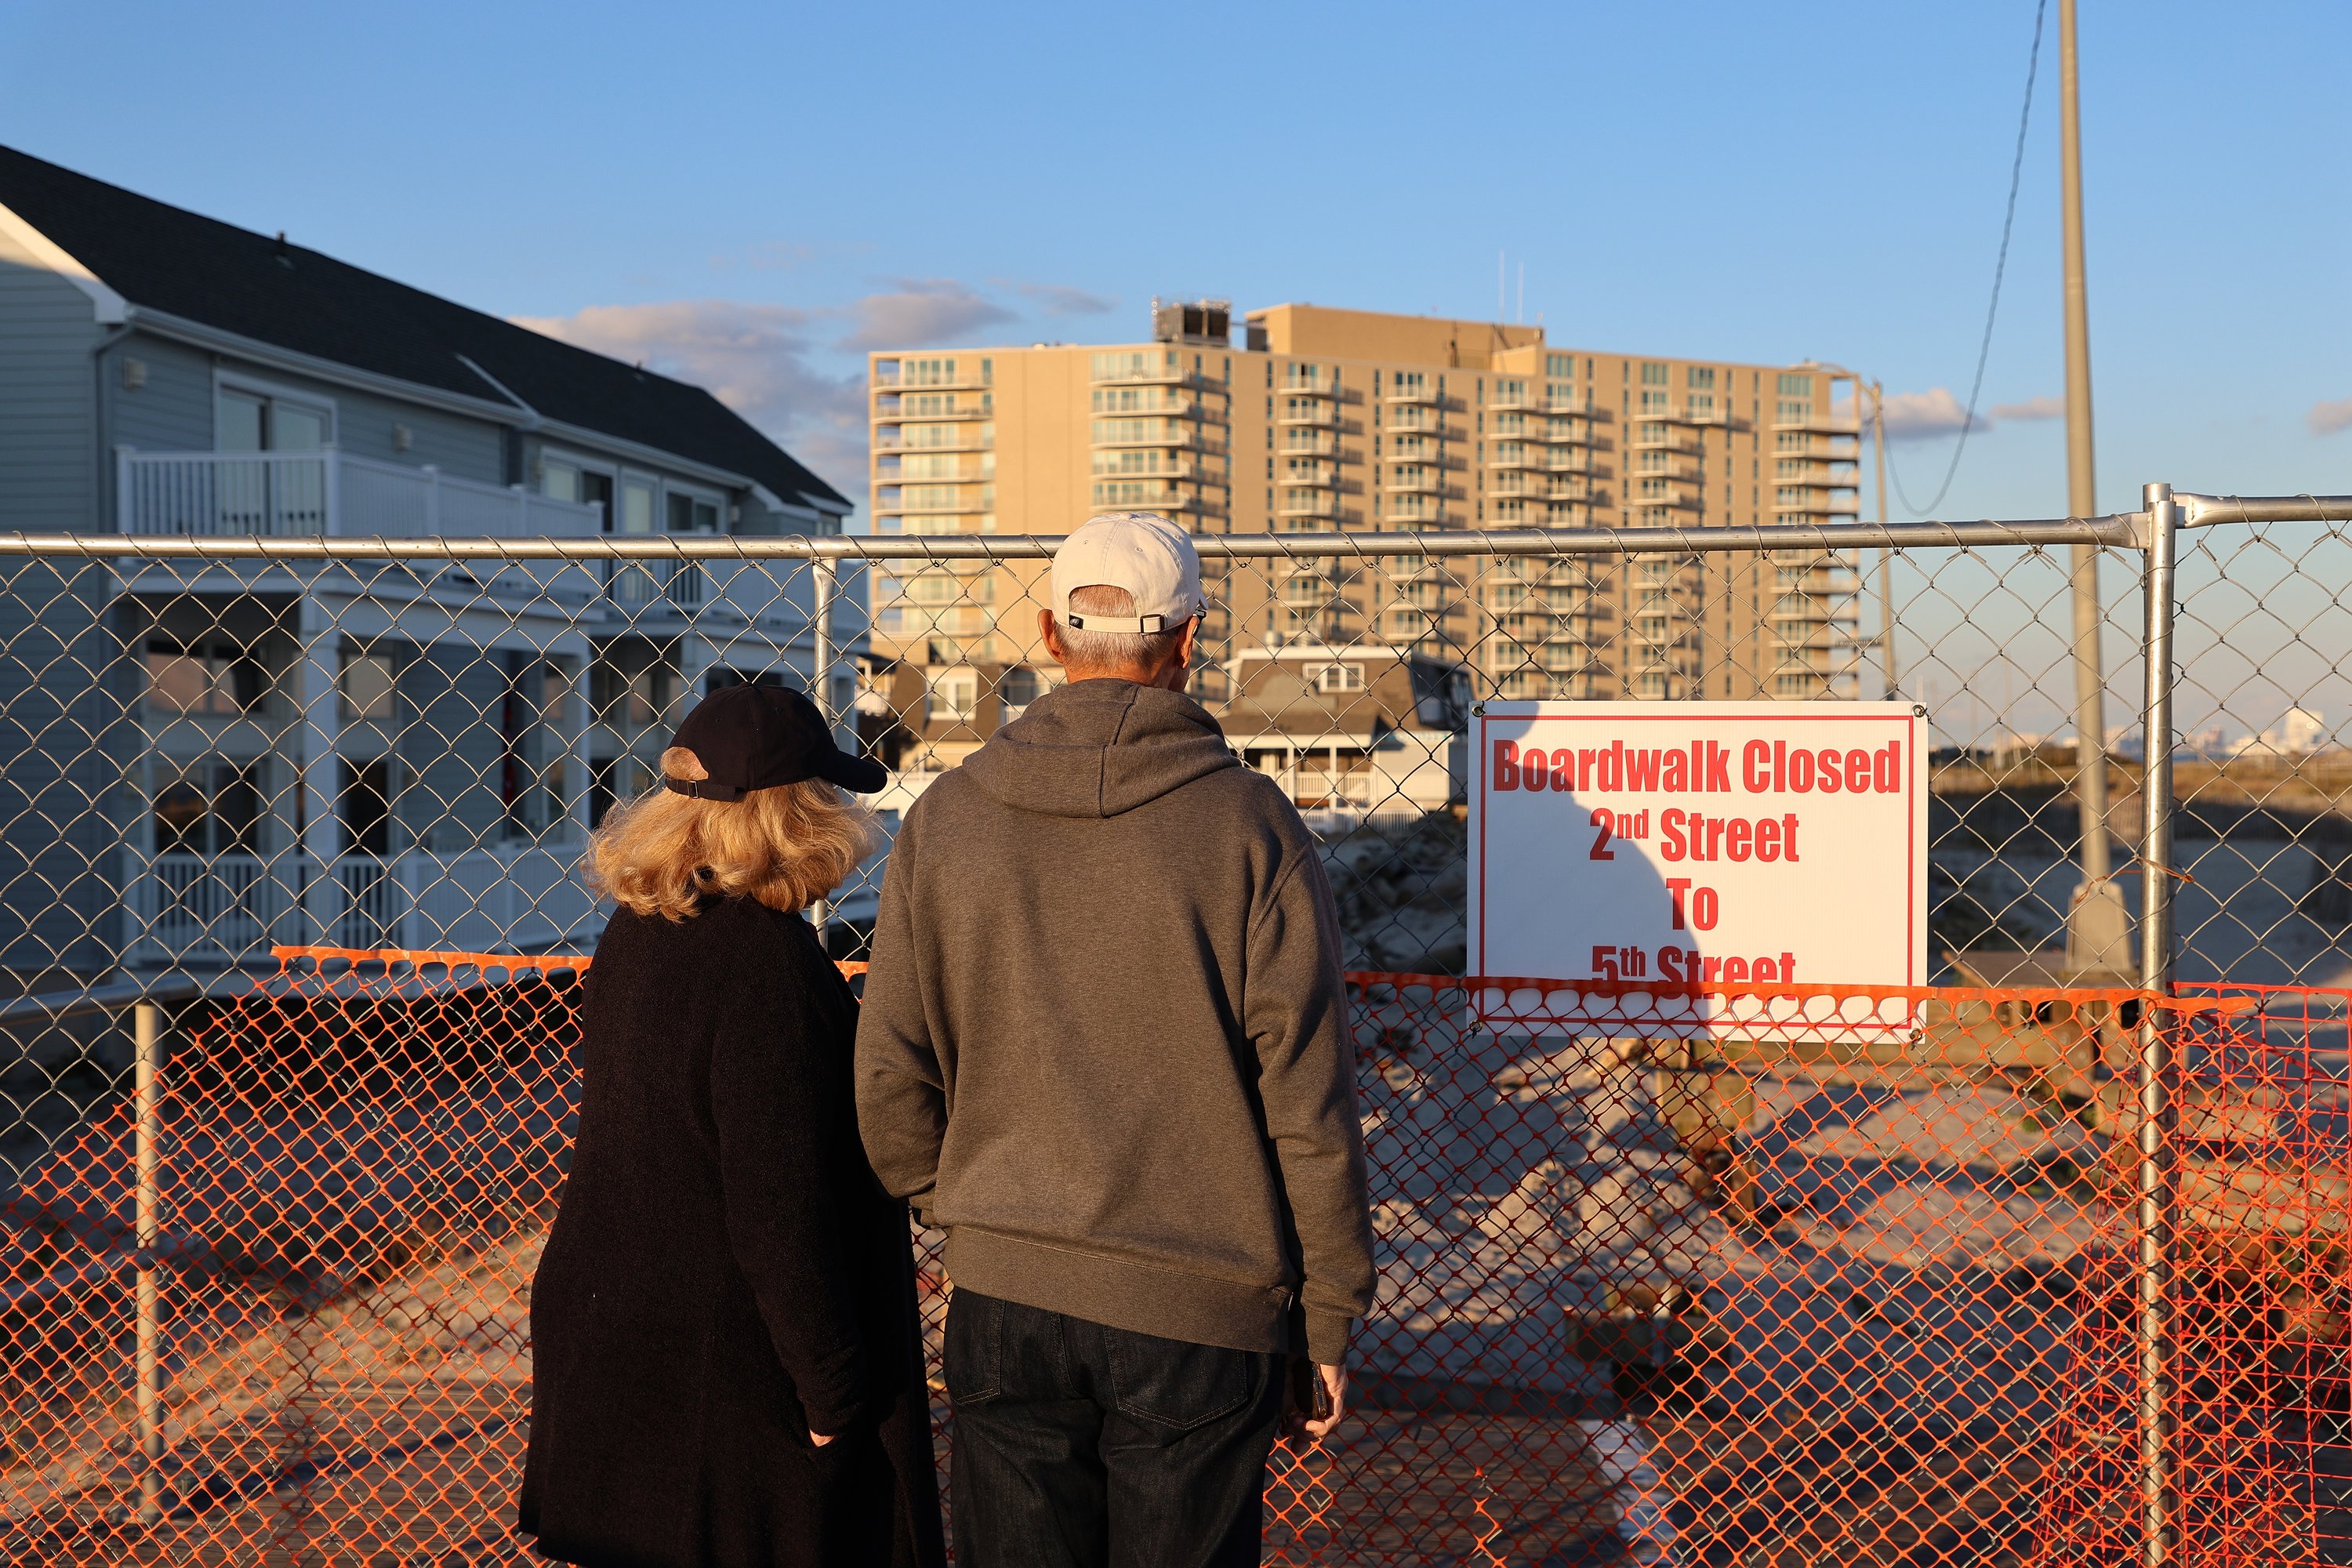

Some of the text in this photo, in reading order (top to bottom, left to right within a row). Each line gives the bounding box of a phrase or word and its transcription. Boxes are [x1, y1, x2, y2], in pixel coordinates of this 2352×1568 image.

[1493, 739, 1900, 793] Boardwalk Closed
[1589, 808, 1799, 862] 2nd Street
[1666, 878, 1719, 931] To
[1592, 946, 1796, 1001] 5th Street
